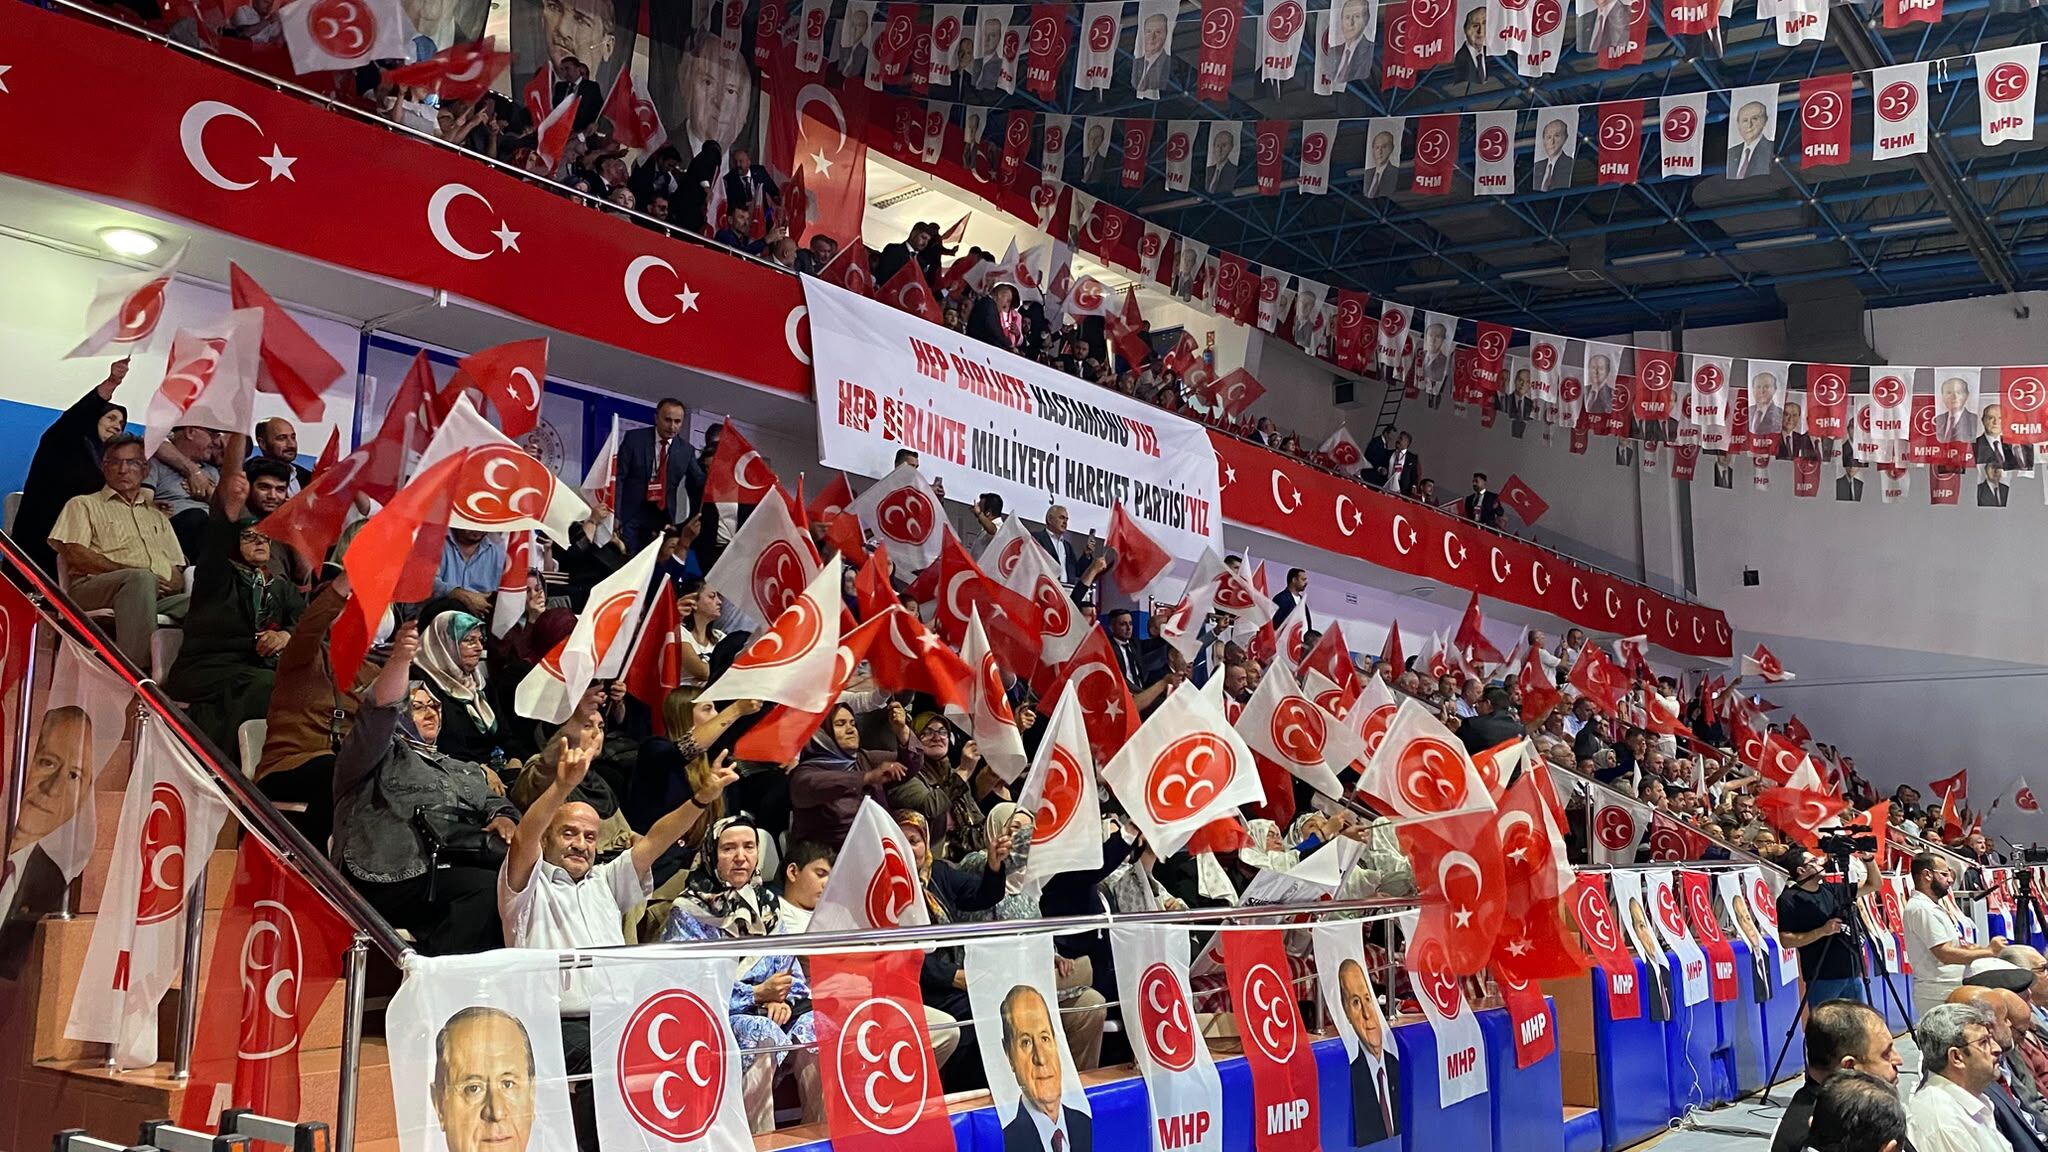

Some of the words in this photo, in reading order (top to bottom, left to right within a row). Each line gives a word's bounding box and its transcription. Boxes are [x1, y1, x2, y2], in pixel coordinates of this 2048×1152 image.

[1990, 117, 2023, 134] MHP
[909, 336, 950, 381] HEP
[951, 346, 1032, 415] BİRLİKTE
[838, 379, 878, 433] HEP
[883, 386, 967, 466] BİRLİKTE
[971, 420, 1060, 505] MİLLİYETÇİ
[1065, 457, 1130, 509] HAREKET
[1134, 477, 1210, 538] PARTİSİ'YİZ
[1858, 443, 1879, 452] MHP
[1915, 446, 1940, 456] MHP
[1613, 974, 1633, 995] MHP
[1685, 960, 1702, 982] MHP
[1715, 962, 1733, 980] MHP
[1521, 1012, 1546, 1046] MHP
[1447, 1046, 1476, 1080] MHP
[1158, 1111, 1210, 1150] MHP
[1267, 1099, 1309, 1135] MHP
